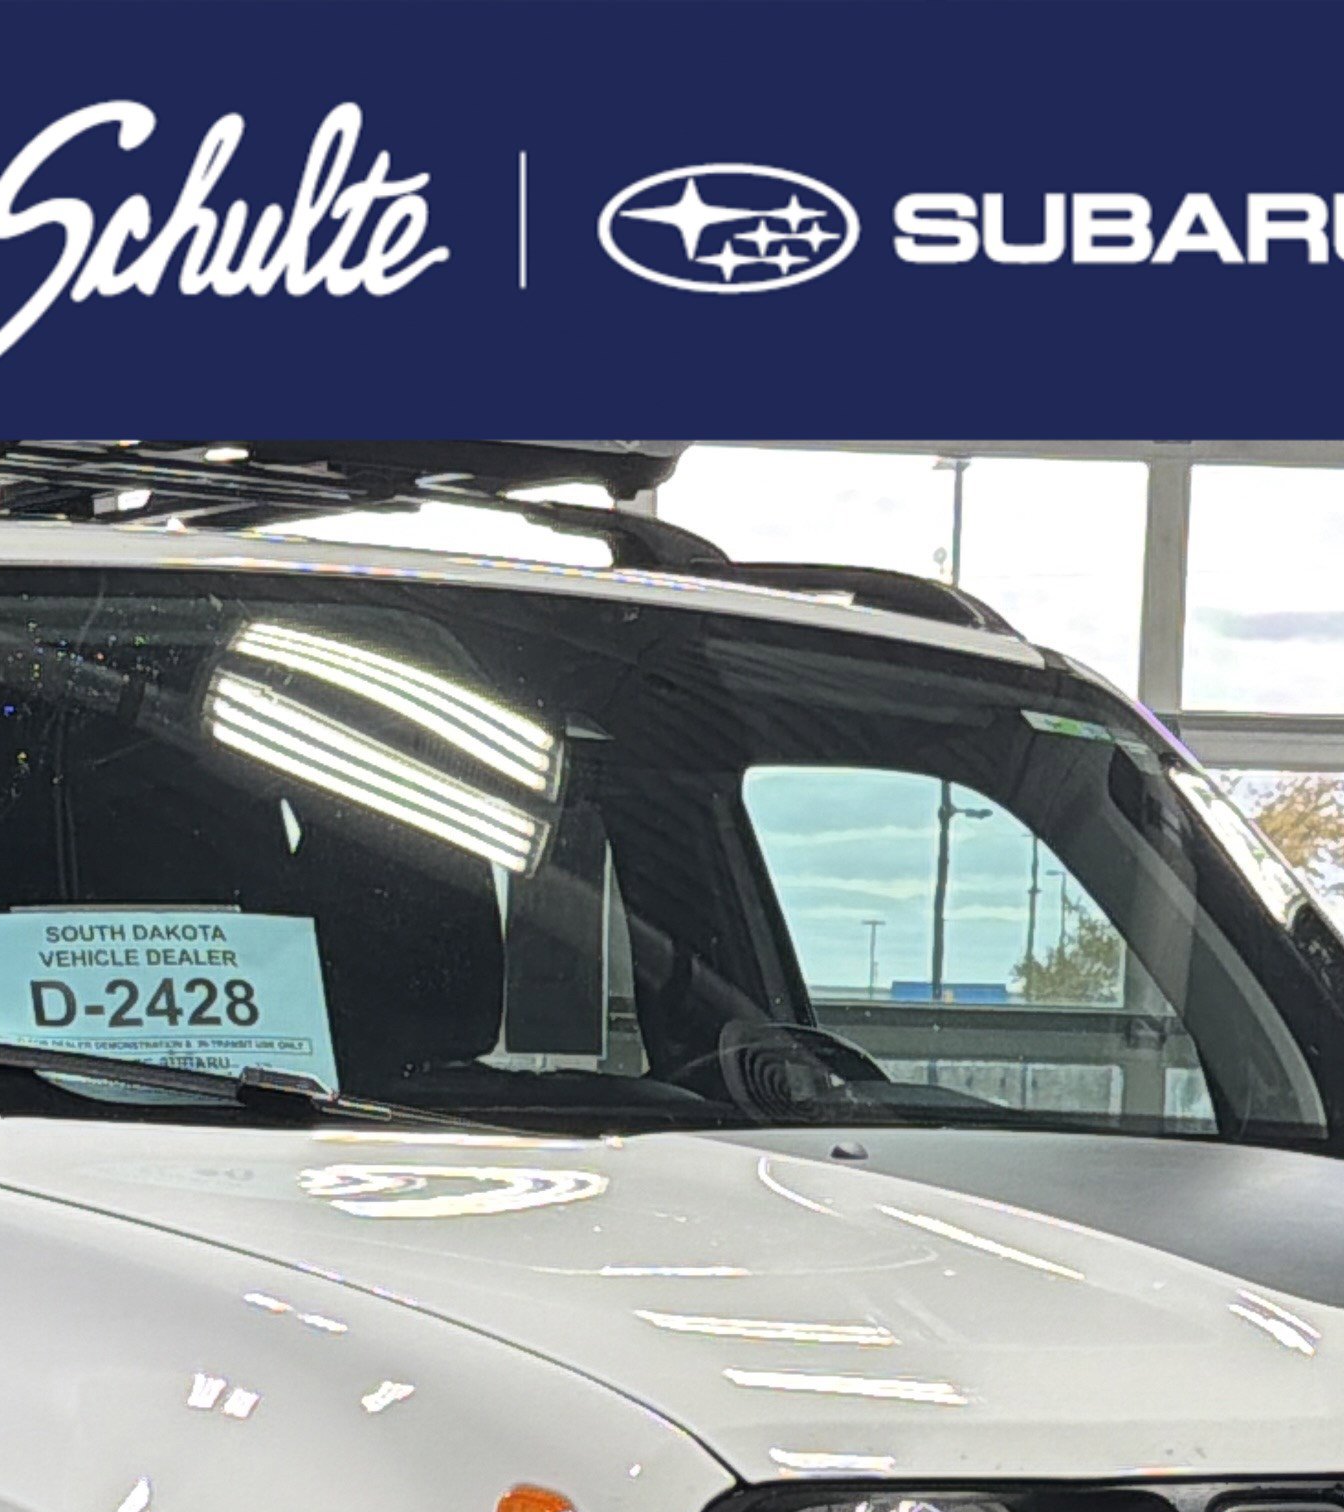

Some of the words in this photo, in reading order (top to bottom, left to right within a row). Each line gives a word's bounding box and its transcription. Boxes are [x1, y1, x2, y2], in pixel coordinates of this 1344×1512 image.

[46, 924, 126, 943] SOUTH
[132, 924, 227, 942] DAKOTA
[39, 949, 140, 968] VEHICLE
[145, 948, 238, 968] DEALER
[30, 977, 260, 1028] D-2428
